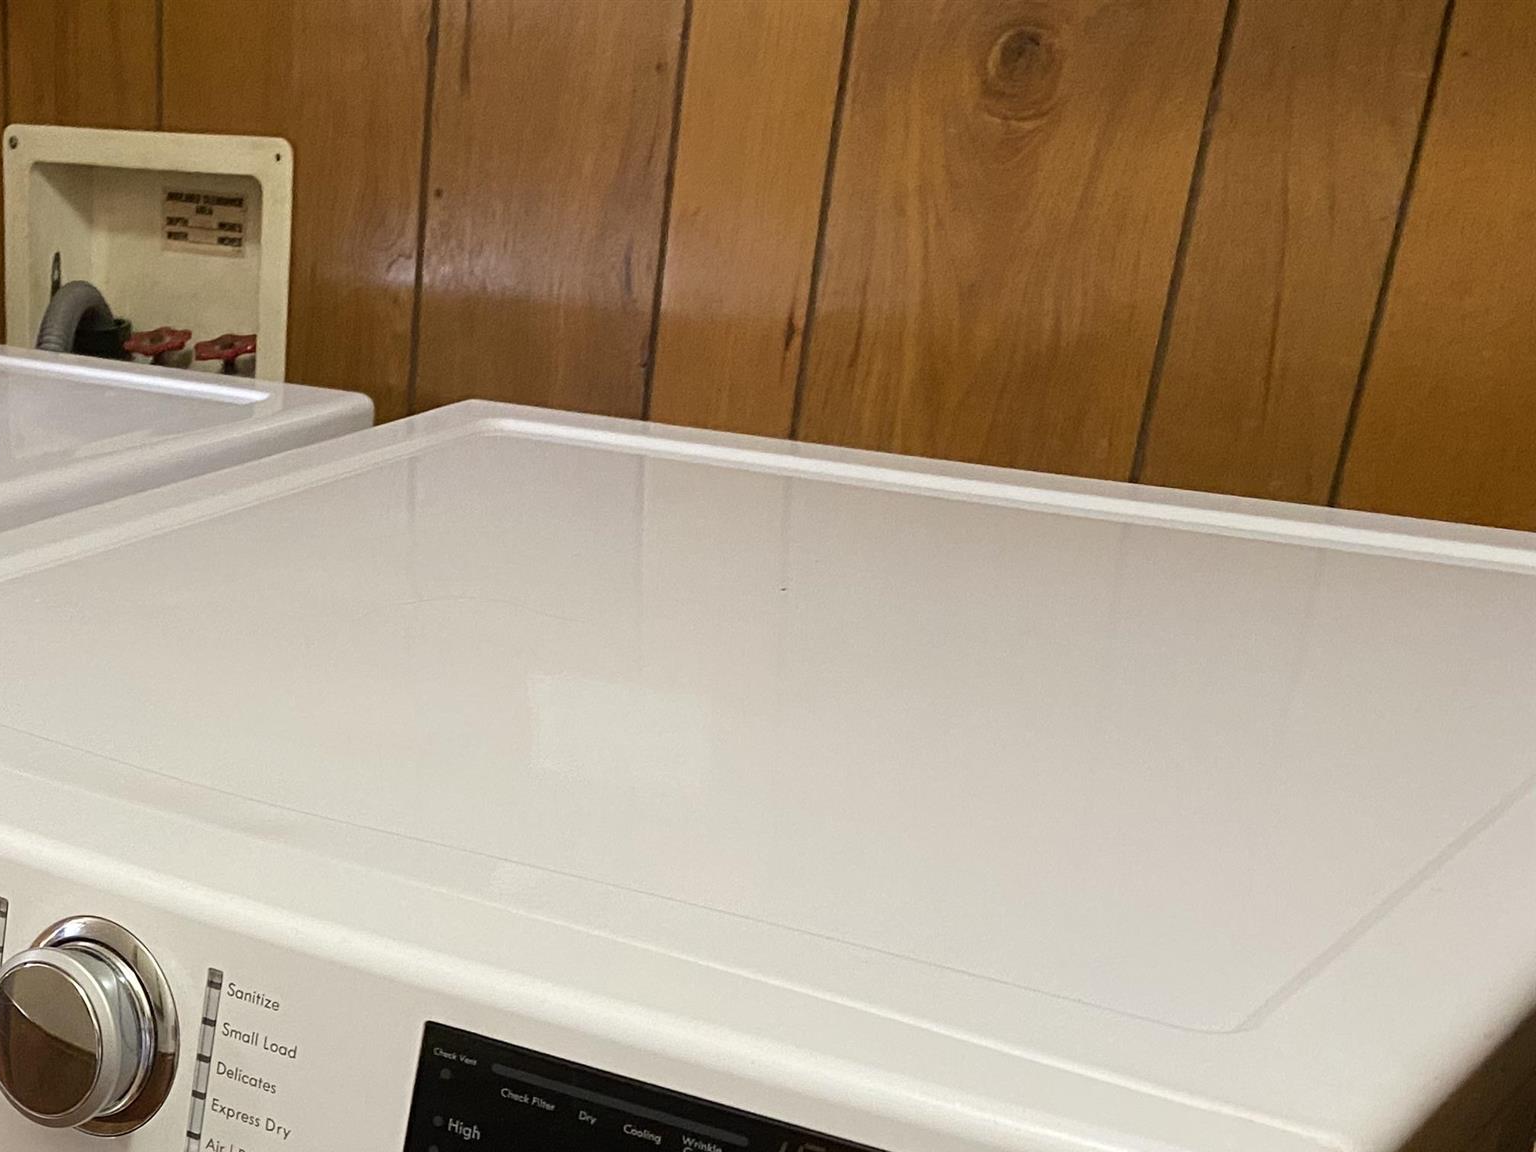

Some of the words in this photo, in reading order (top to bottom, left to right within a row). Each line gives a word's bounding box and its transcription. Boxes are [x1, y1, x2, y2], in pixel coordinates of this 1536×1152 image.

[226, 982, 280, 1011] Sanitize
[222, 1023, 259, 1046] Small
[263, 1036, 298, 1059] Load
[216, 1061, 277, 1094] Delicates
[500, 1088, 530, 1104] Check
[531, 1096, 555, 1111] Filter
[211, 1098, 261, 1128] Express
[265, 1118, 291, 1140] Dry
[447, 1118, 481, 1140] High
[578, 1110, 597, 1125] Dry
[623, 1123, 662, 1145] Cooling
